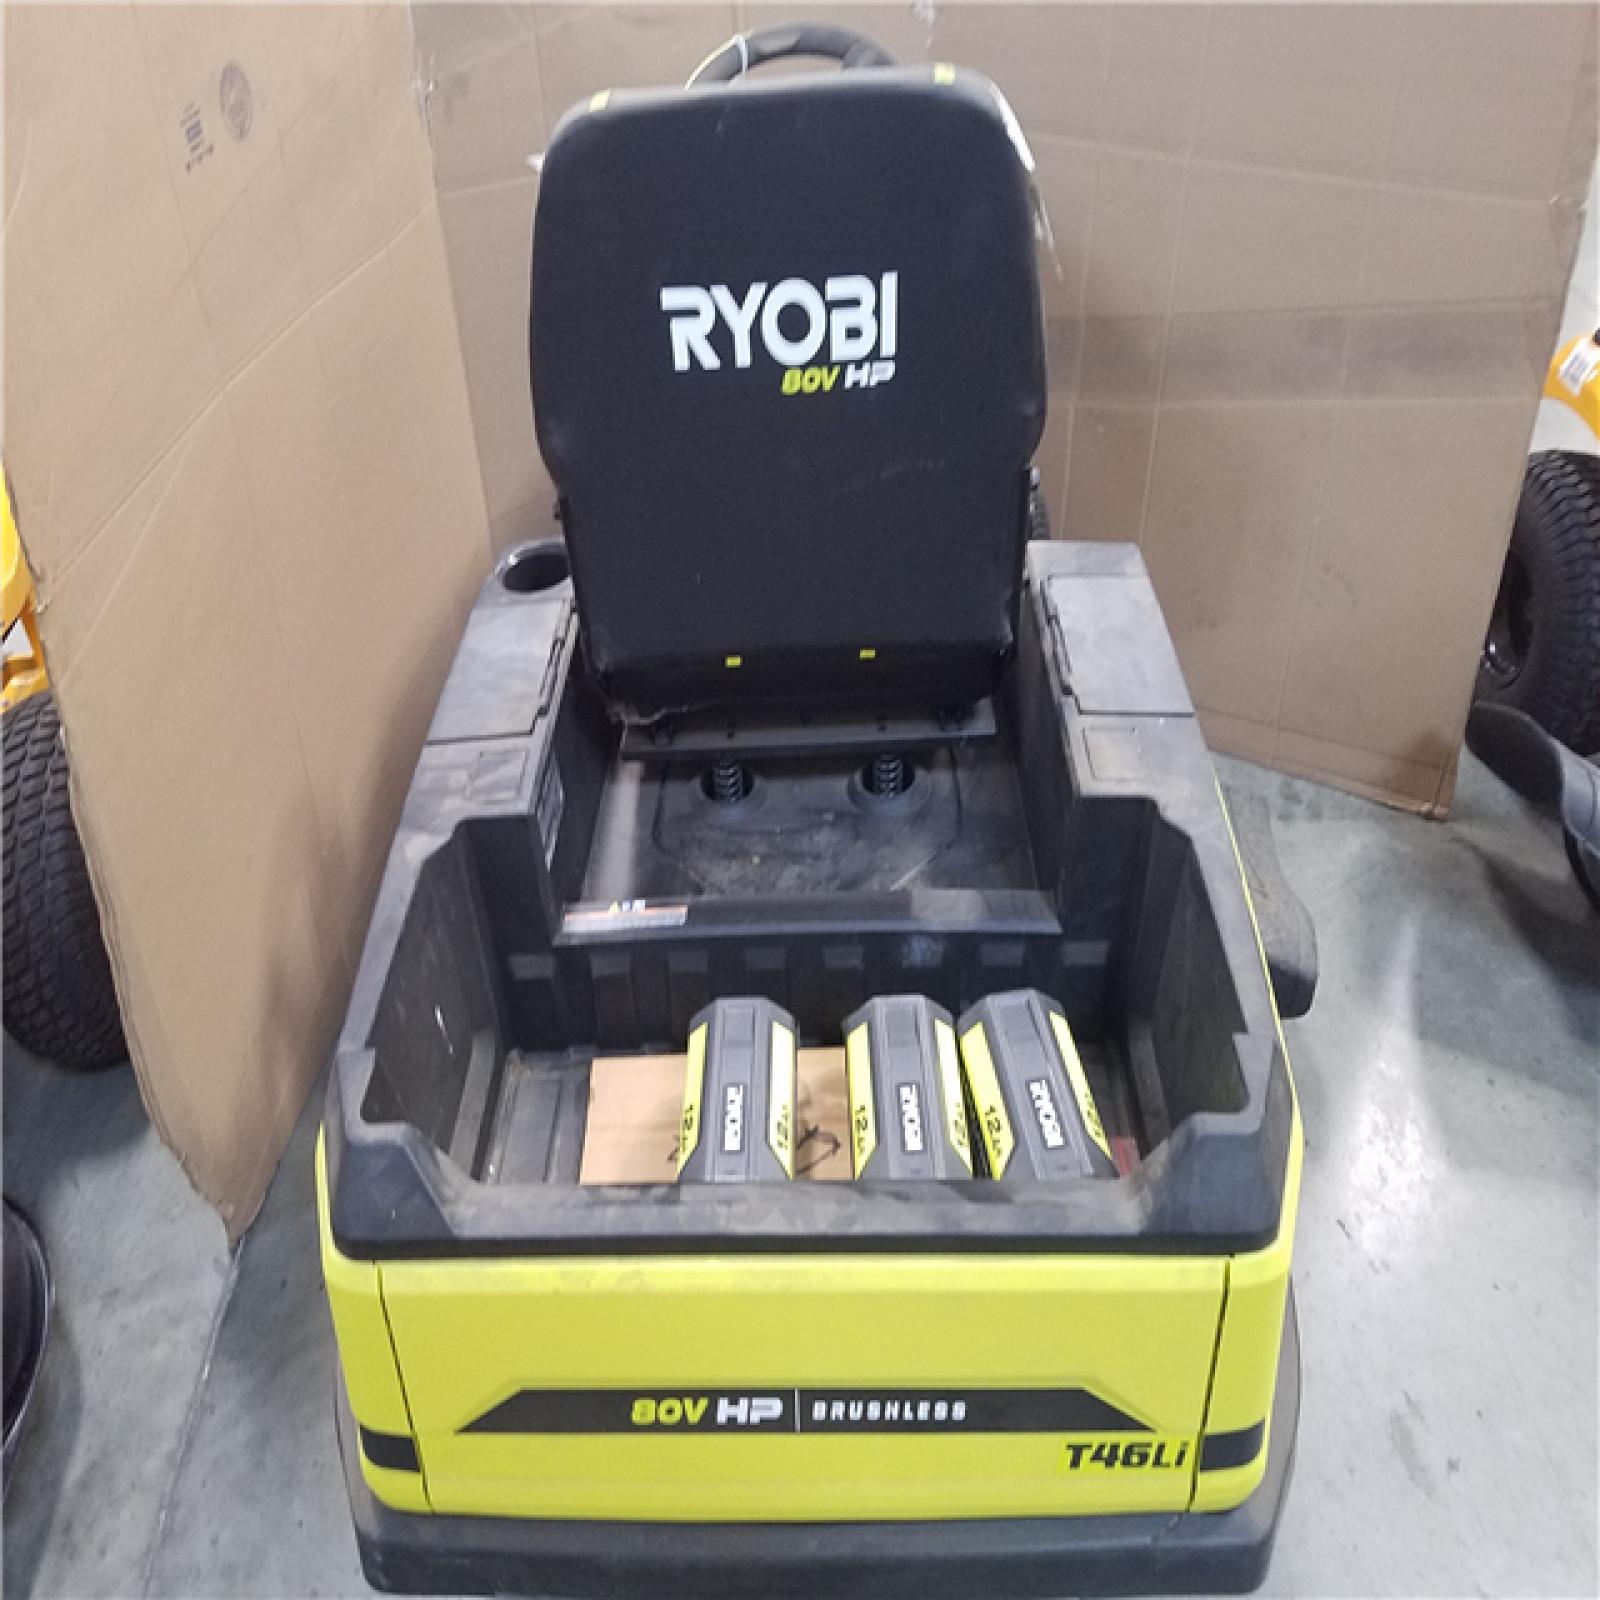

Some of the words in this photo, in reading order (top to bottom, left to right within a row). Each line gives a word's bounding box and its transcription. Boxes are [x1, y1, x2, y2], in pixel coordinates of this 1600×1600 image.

[660, 270, 898, 373] RYOBI
[780, 365, 841, 395] 80V
[844, 360, 896, 389] HP
[724, 1084, 743, 1151] RYOBI
[900, 1084, 923, 1151] RYOBI
[1029, 1079, 1064, 1147] RYOBI
[631, 1397, 708, 1425] 80V
[716, 1397, 783, 1425] HP
[812, 1400, 967, 1421] BRUSHLESS
[1066, 1441, 1189, 1469] T46Li
